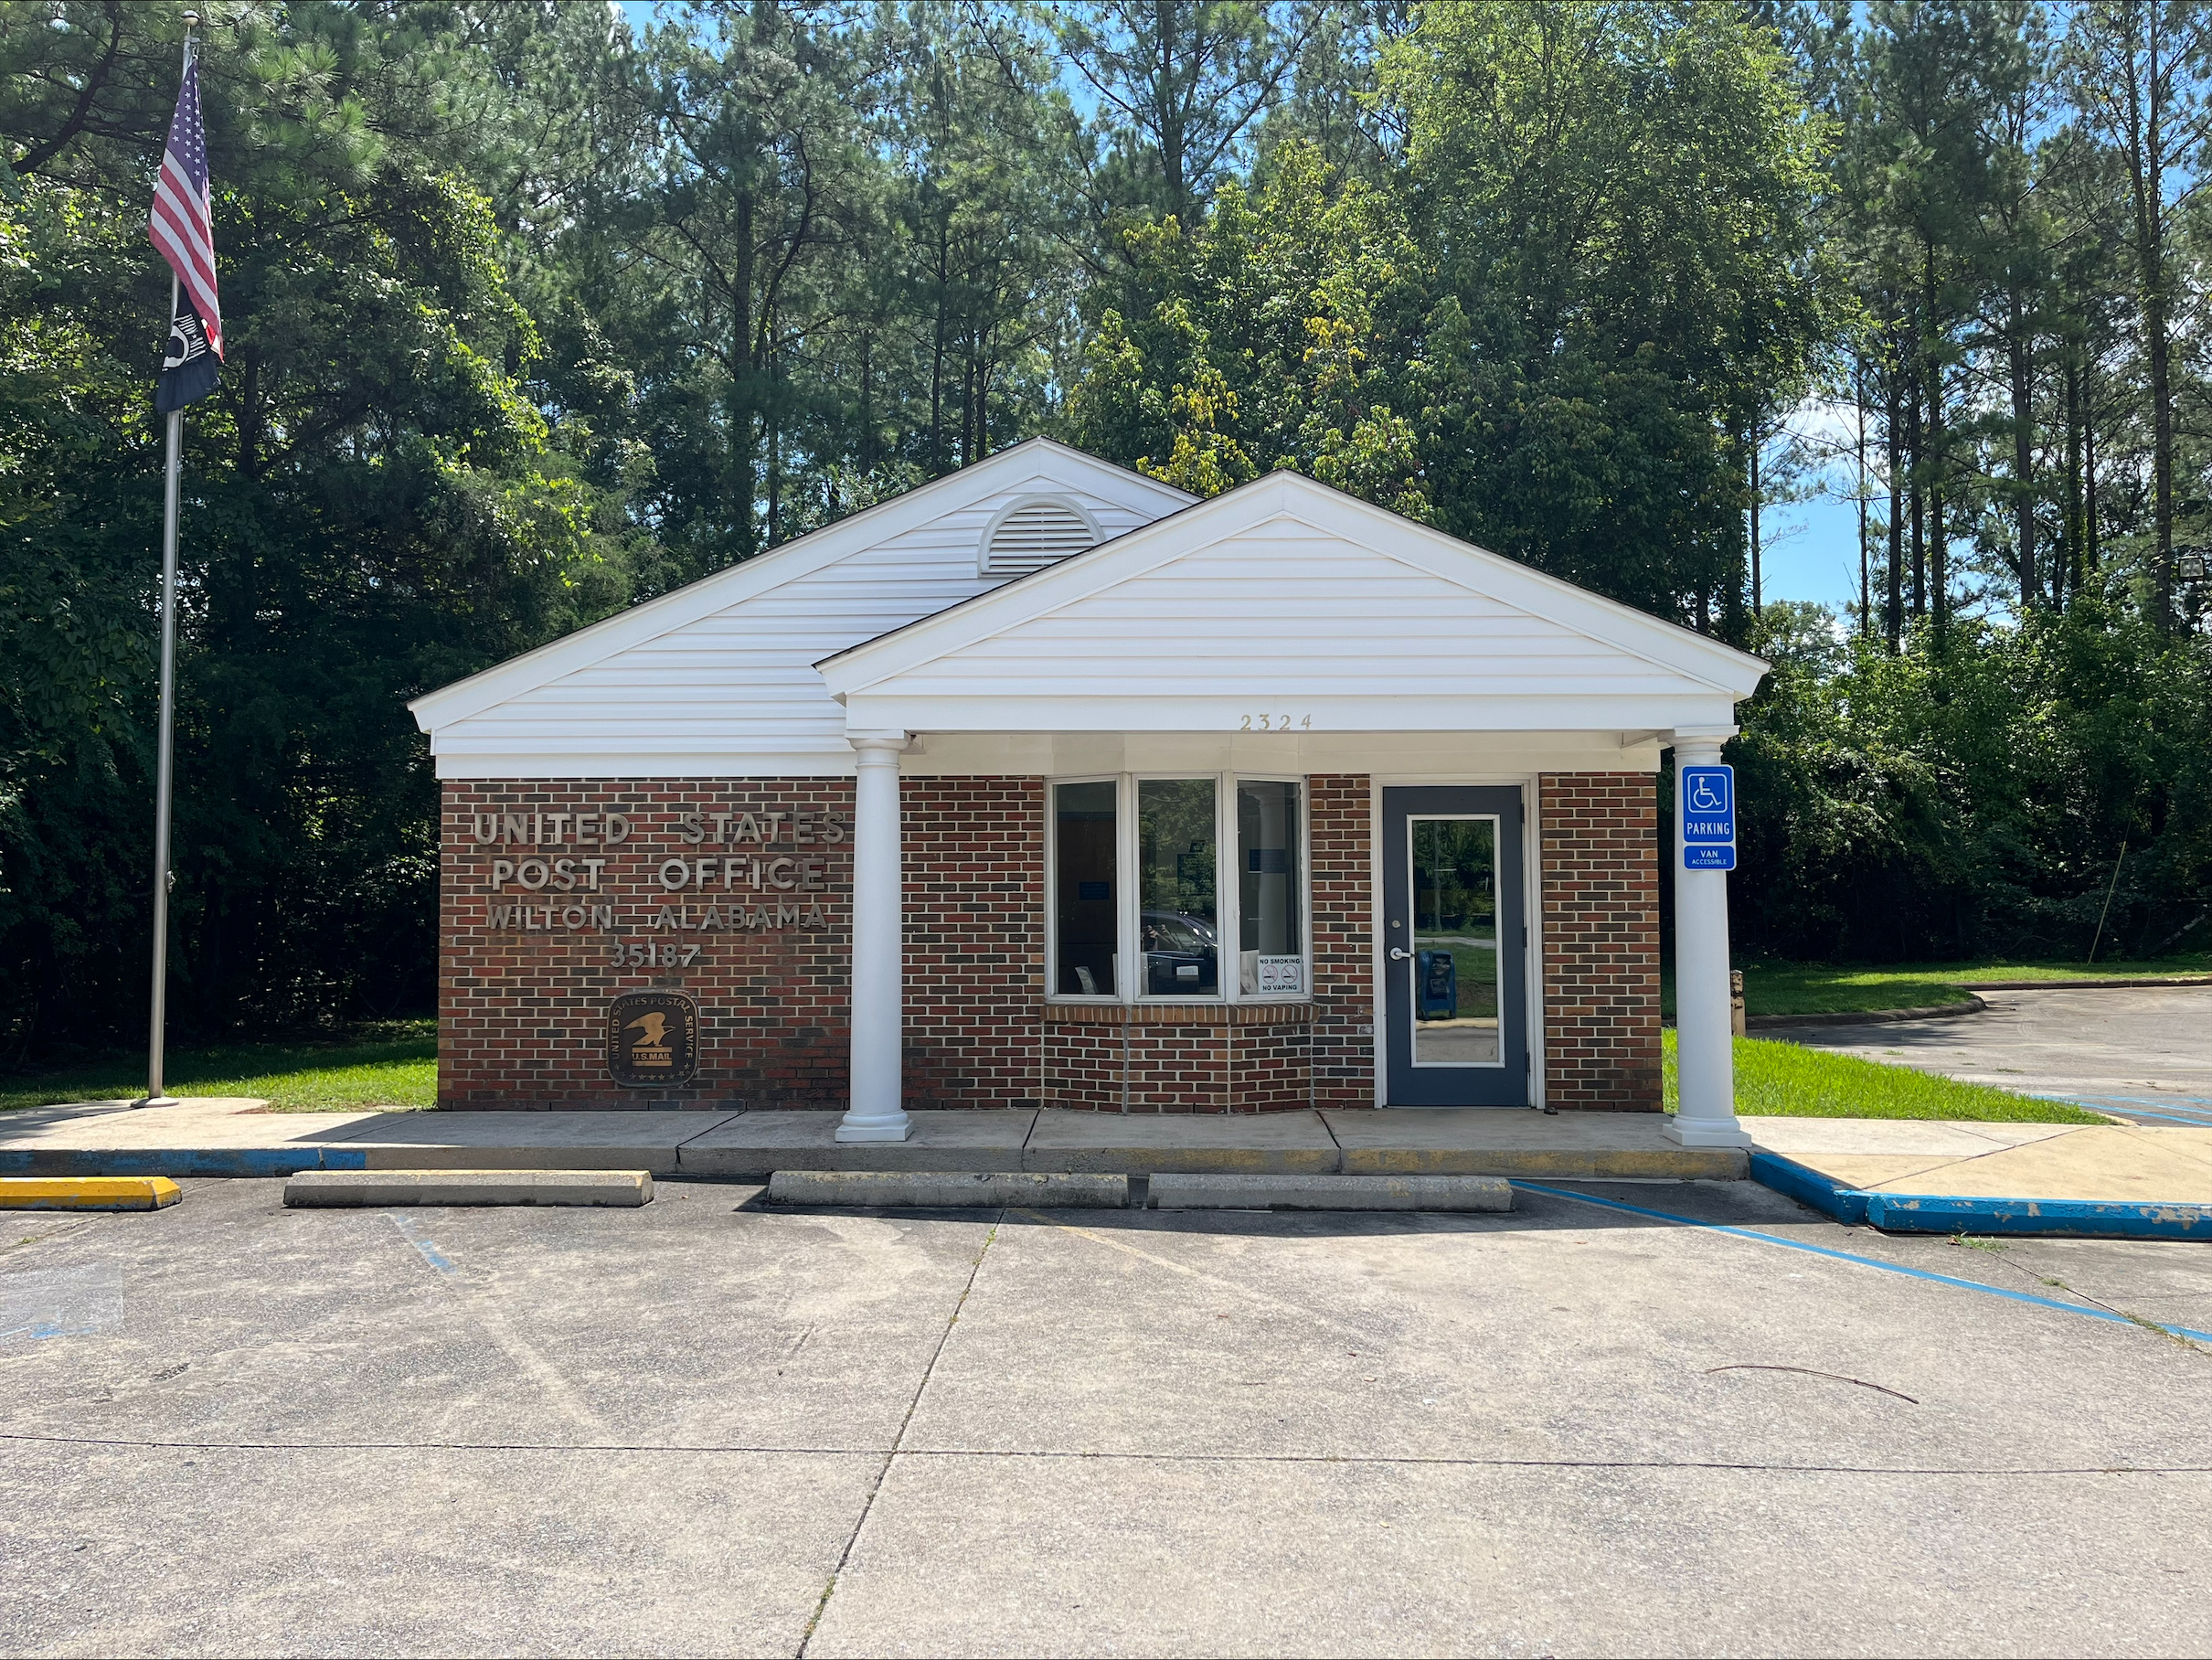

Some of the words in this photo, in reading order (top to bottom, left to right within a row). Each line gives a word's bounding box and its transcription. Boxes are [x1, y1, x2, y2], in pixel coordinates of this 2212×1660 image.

[1240, 713, 1312, 730] 2324
[473, 814, 630, 846] UNITED
[682, 812, 846, 845] STATES
[1686, 823, 1730, 835] PARKING
[1700, 850, 1718, 858] VAN
[492, 858, 606, 891] POST
[658, 857, 826, 890] OFFICE
[487, 905, 612, 931] WILTON
[654, 904, 827, 930] ALABAMA
[610, 943, 702, 968] 35187
[613, 997, 647, 1016] STATES
[650, 997, 691, 1014] POSTAL
[611, 1018, 620, 1060] UNITED
[685, 1015, 694, 1059] SERVICE
